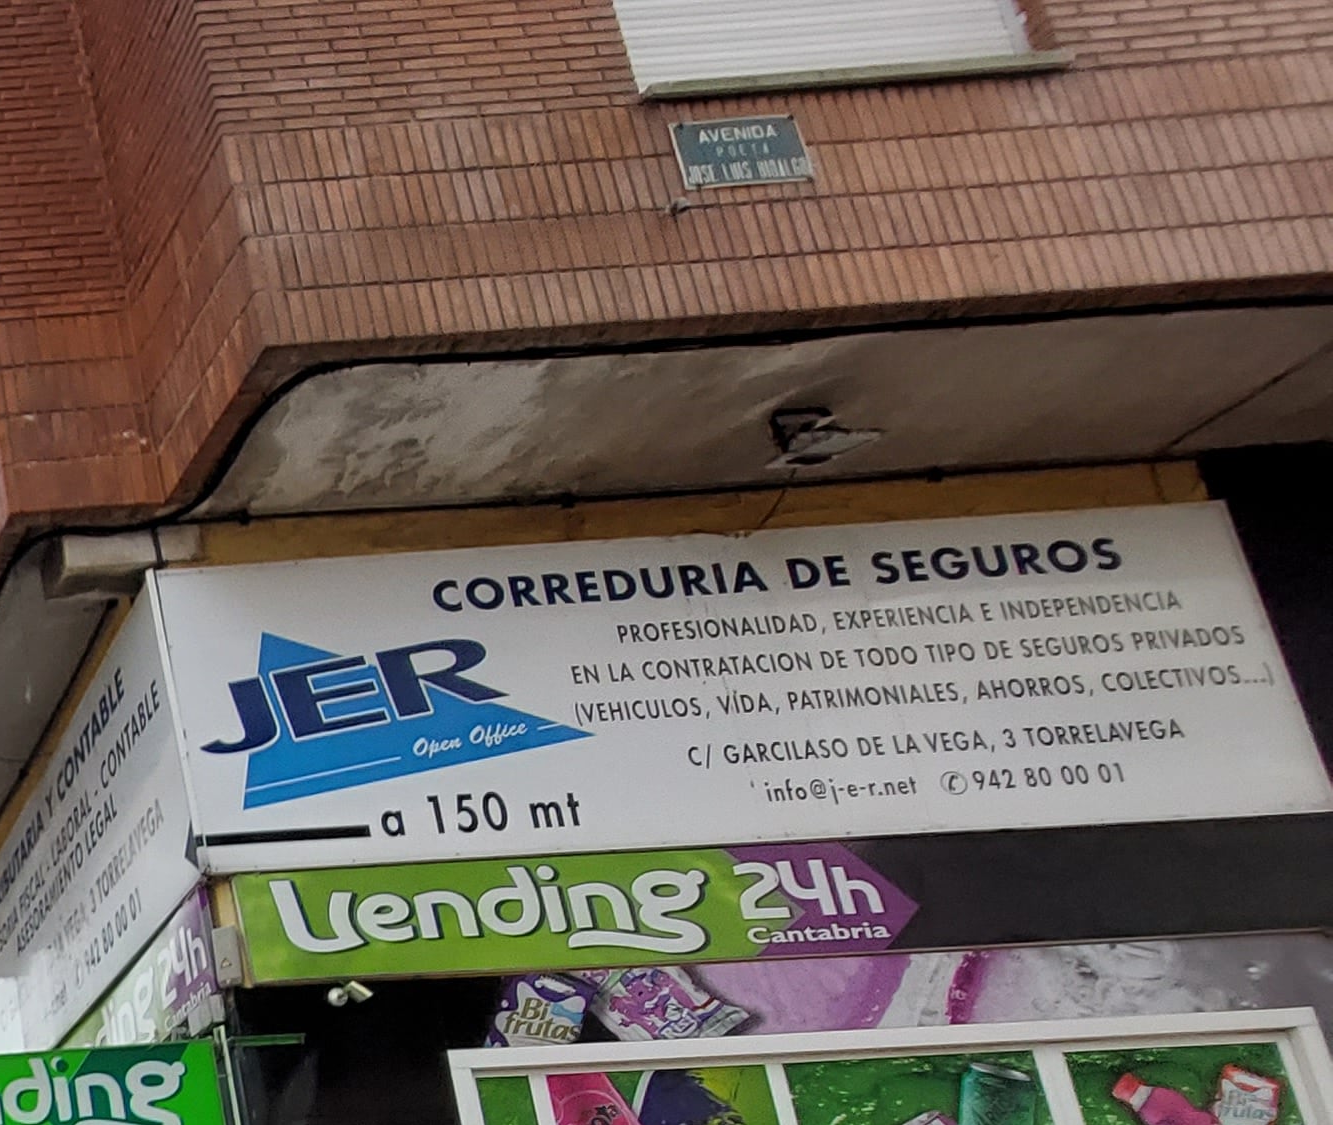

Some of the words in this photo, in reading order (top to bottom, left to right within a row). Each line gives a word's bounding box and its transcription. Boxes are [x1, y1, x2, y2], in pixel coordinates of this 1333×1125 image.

[698, 124, 778, 144] AVENIDA
[716, 142, 770, 157] POETA
[433, 561, 768, 612] CORREDURIA
[785, 554, 851, 590] DE
[871, 538, 1122, 584] SEGUROS
[617, 612, 826, 644] PROFESIONALIDAD,
[833, 603, 973, 631] EXPERIENCIA
[981, 602, 993, 622] E
[1000, 590, 1182, 621] INDEPENDENCIA
[571, 665, 600, 685] EN
[609, 661, 633, 682] LA
[642, 651, 813, 680] CONTRATACION
[821, 648, 849, 669] DE
[854, 645, 917, 667] TODO
[925, 641, 975, 664] TIPO
[984, 639, 1012, 660] DE
[1021, 632, 1124, 658] SEGUROS
[1130, 625, 1245, 650] PRIVADOS
[201, 637, 510, 753] JER
[574, 696, 711, 728] (VEHICULOS,
[788, 681, 968, 710] PATRIMONIALES,
[976, 673, 1094, 700] AHORROS,
[44, 786, 54, 818] Y
[56, 667, 126, 801] CONTABLE
[412, 734, 462, 758] Open
[469, 721, 529, 748] Office
[687, 743, 711, 769] C/
[723, 736, 849, 765] GARCILASO
[856, 735, 883, 757] DE
[893, 733, 920, 755] LA
[927, 729, 995, 753] VEGA,
[1003, 728, 1017, 749] 3
[1023, 718, 1185, 748] TORRELAVEGA
[52, 795, 93, 863] LABORAL
[99, 680, 162, 788] CONTABLE
[765, 775, 917, 805] info@j-e-r.net
[972, 768, 1016, 791] 942
[1024, 765, 1051, 787] 80
[1060, 763, 1089, 786] 00
[1098, 762, 1124, 783] 01
[380, 810, 406, 837] a
[427, 791, 508, 835] 150
[530, 792, 581, 829] mt
[15, 848, 85, 959] ASESORAMIENTO
[84, 793, 118, 856] LEGAL
[95, 798, 165, 904] TORRELAVEGA
[269, 864, 709, 954] Vending
[731, 859, 885, 921] 24h
[747, 922, 892, 947] Cantabria
[157, 926, 208, 1009] 24h
[503, 1011, 581, 1041] frutas
[520, 997, 549, 1021] Bi
